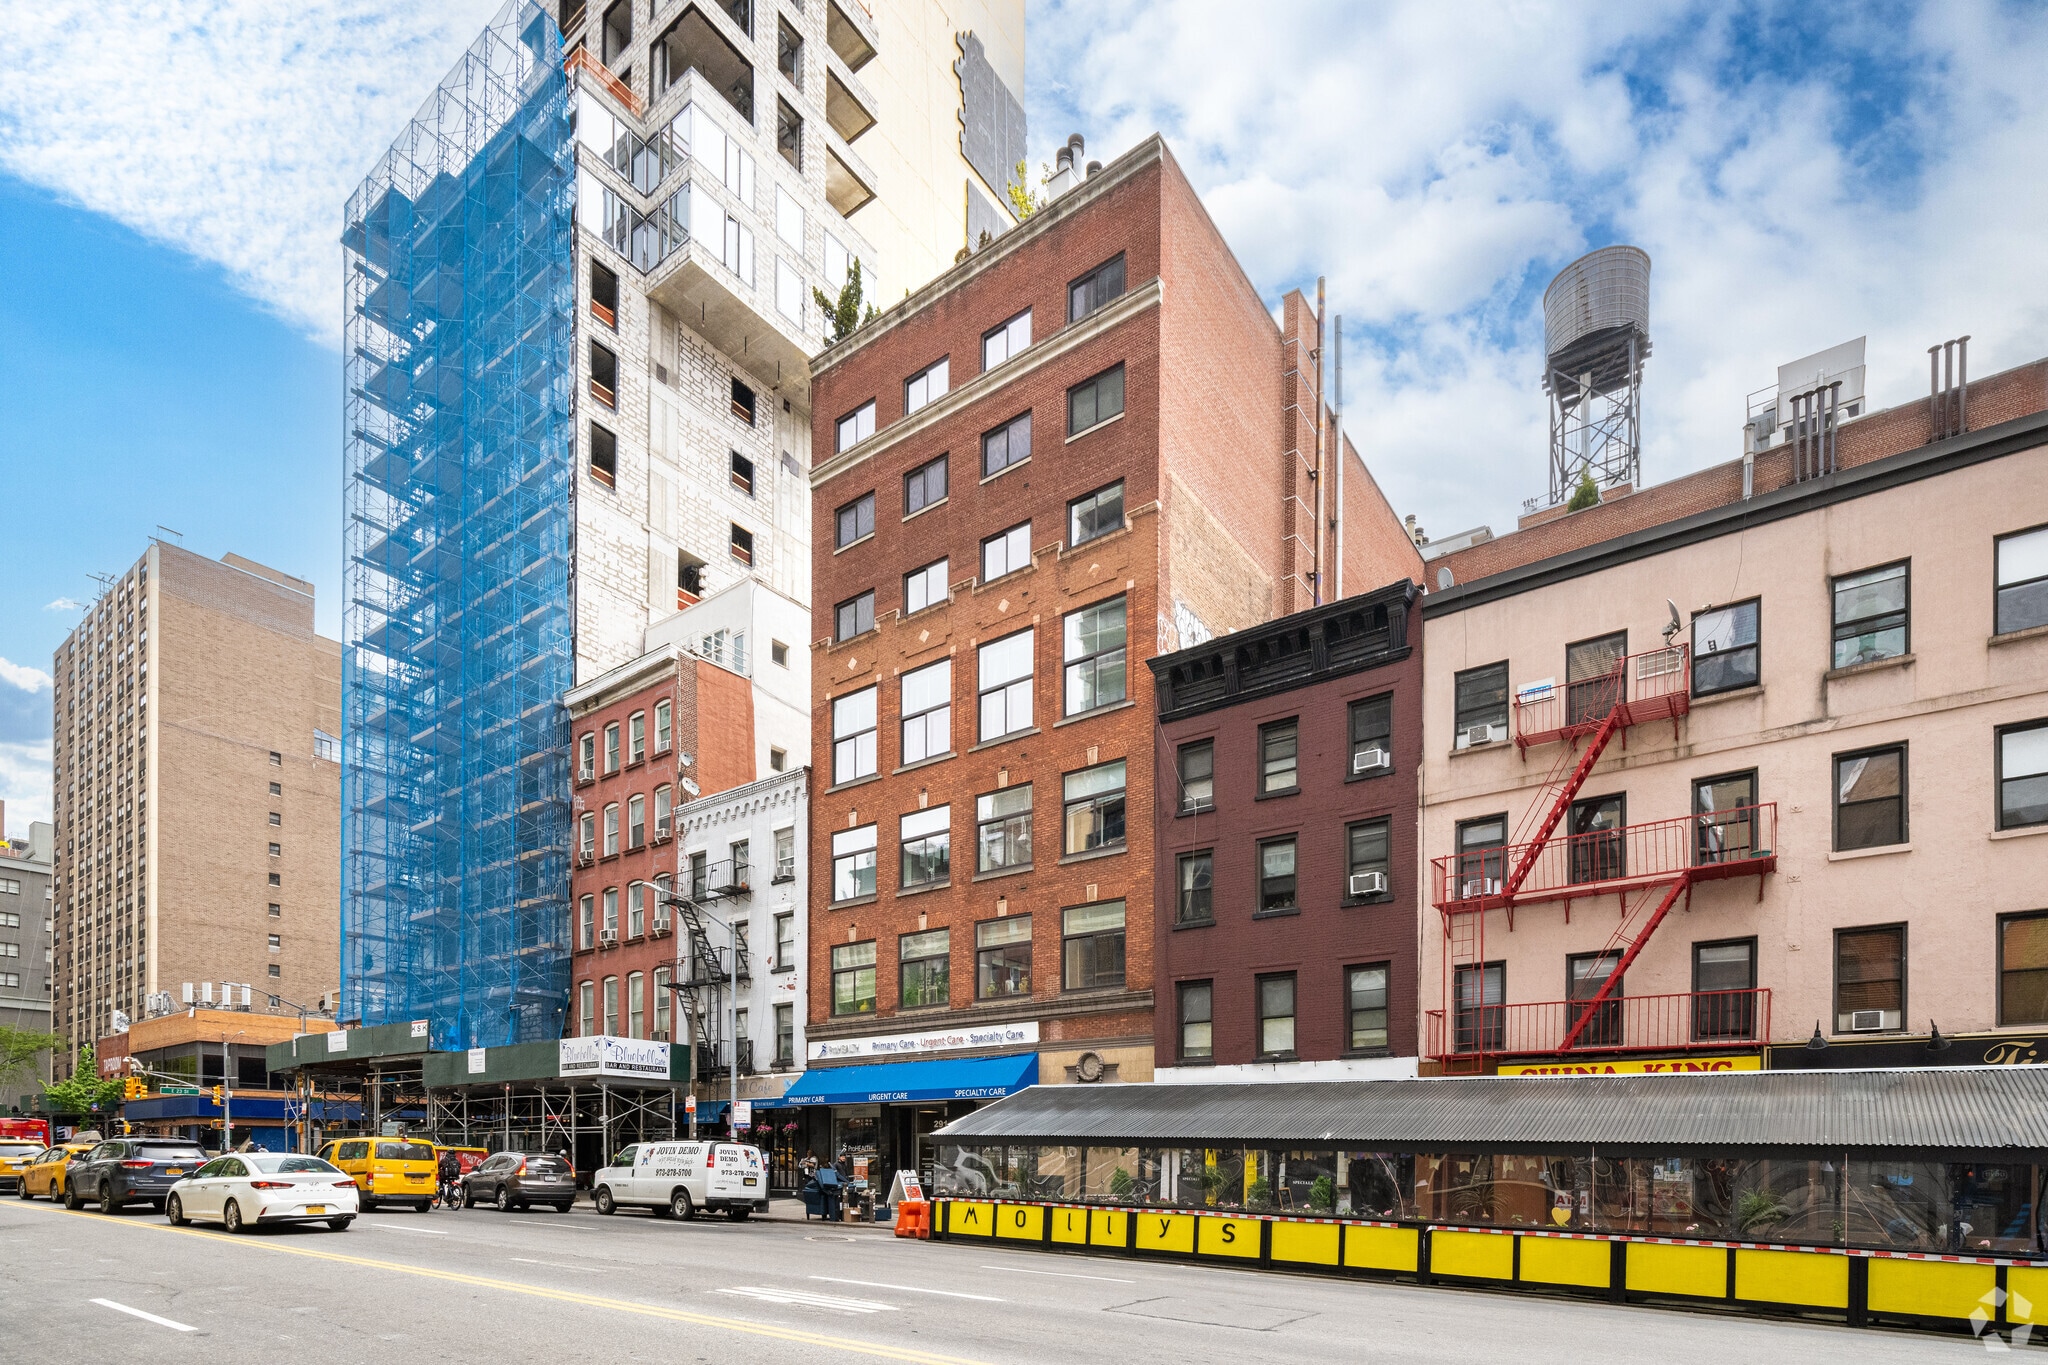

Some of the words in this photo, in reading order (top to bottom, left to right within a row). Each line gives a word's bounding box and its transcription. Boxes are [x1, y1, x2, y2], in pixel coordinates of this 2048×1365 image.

[872, 1042, 898, 1052] Primary
[899, 1040, 916, 1049] Care
[920, 1037, 946, 1048] Urgent
[947, 1035, 964, 1045] Care
[970, 1031, 1004, 1044] Specialty
[1006, 1030, 1024, 1040] Care
[609, 1044, 655, 1065] Bluebell
[631, 1064, 666, 1073] RESTAURANT
[749, 1081, 773, 1095] Cafe
[788, 1096, 811, 1104] PRIMARY
[812, 1095, 825, 1103] CARE
[868, 1093, 891, 1101] URGENT
[892, 1092, 908, 1100] CARE
[954, 1089, 988, 1098] SPECIALTY
[988, 1087, 1006, 1096] CARE
[933, 1120, 948, 1128] 291
[656, 1146, 678, 1155] JOVIN
[677, 1146, 700, 1155] DEMO
[655, 1168, 693, 1177] 973-278-5700
